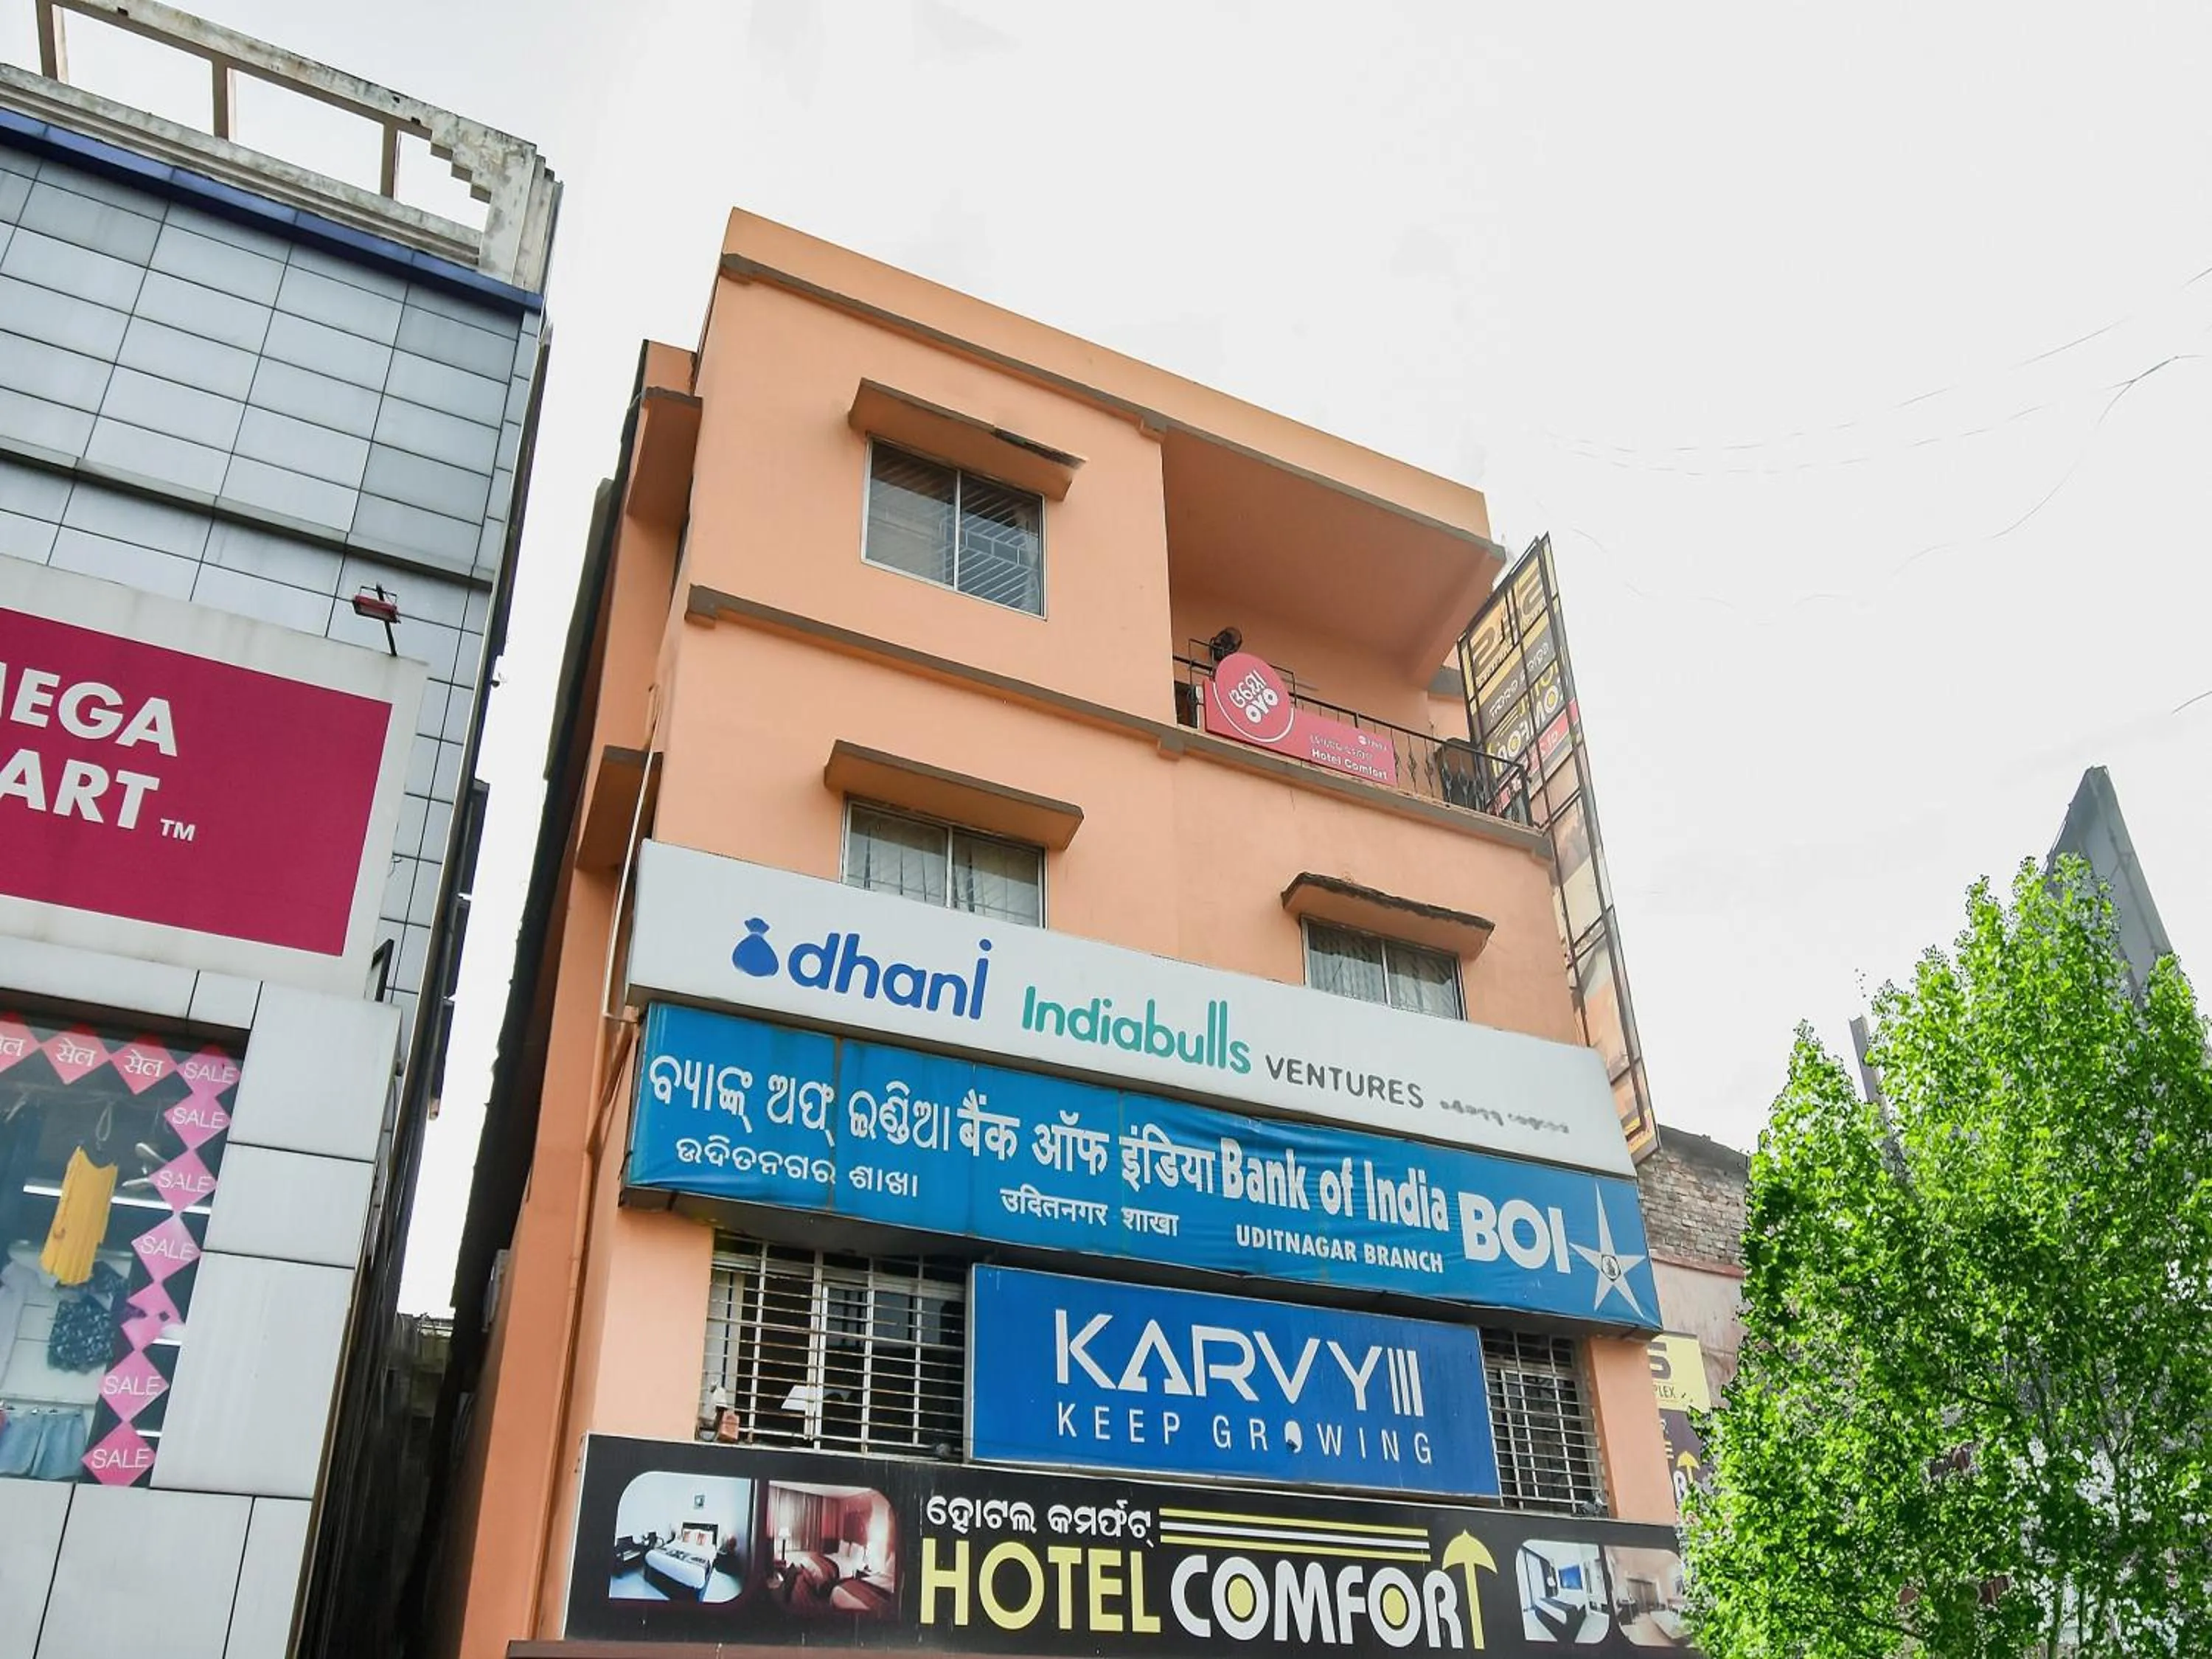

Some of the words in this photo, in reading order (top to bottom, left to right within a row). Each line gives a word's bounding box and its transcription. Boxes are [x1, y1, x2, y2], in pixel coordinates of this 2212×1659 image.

[0, 661, 178, 757] EGA
[1245, 687, 1279, 723] OYO
[160, 818, 195, 841] TM
[787, 932, 992, 1020] dhani
[1022, 985, 1251, 1074] Indiabulls
[1265, 1054, 1424, 1108] VENTURES
[55, 1037, 97, 1067] सेल
[124, 1048, 164, 1078] सेल
[184, 1062, 237, 1085] SALE
[172, 1107, 226, 1130] SALE
[957, 1089, 1020, 1161] बैंक
[1032, 1110, 1109, 1175] ऑफ
[1119, 1123, 1215, 1193] इंडिया
[157, 1169, 214, 1193] SALE
[1000, 1183, 1108, 1227] उदितनगर
[1121, 1206, 1179, 1237] शाखा
[1220, 1138, 1310, 1211] Bank
[1320, 1157, 1354, 1218] of
[1365, 1161, 1450, 1232] India
[1458, 1191, 1571, 1274] BOI
[140, 1235, 196, 1262] SALE
[1236, 1224, 1357, 1263] UDITNAGAR
[1364, 1242, 1444, 1273] BRANCH
[1055, 1309, 1382, 1411] KARVY
[102, 1376, 161, 1397] SALE
[1057, 1402, 1180, 1445] KEEP
[1213, 1415, 1433, 1466] GROWING
[91, 1447, 152, 1470] SALE
[919, 1537, 1162, 1634] HOTEL
[1170, 1528, 1498, 1650] COMFORT
